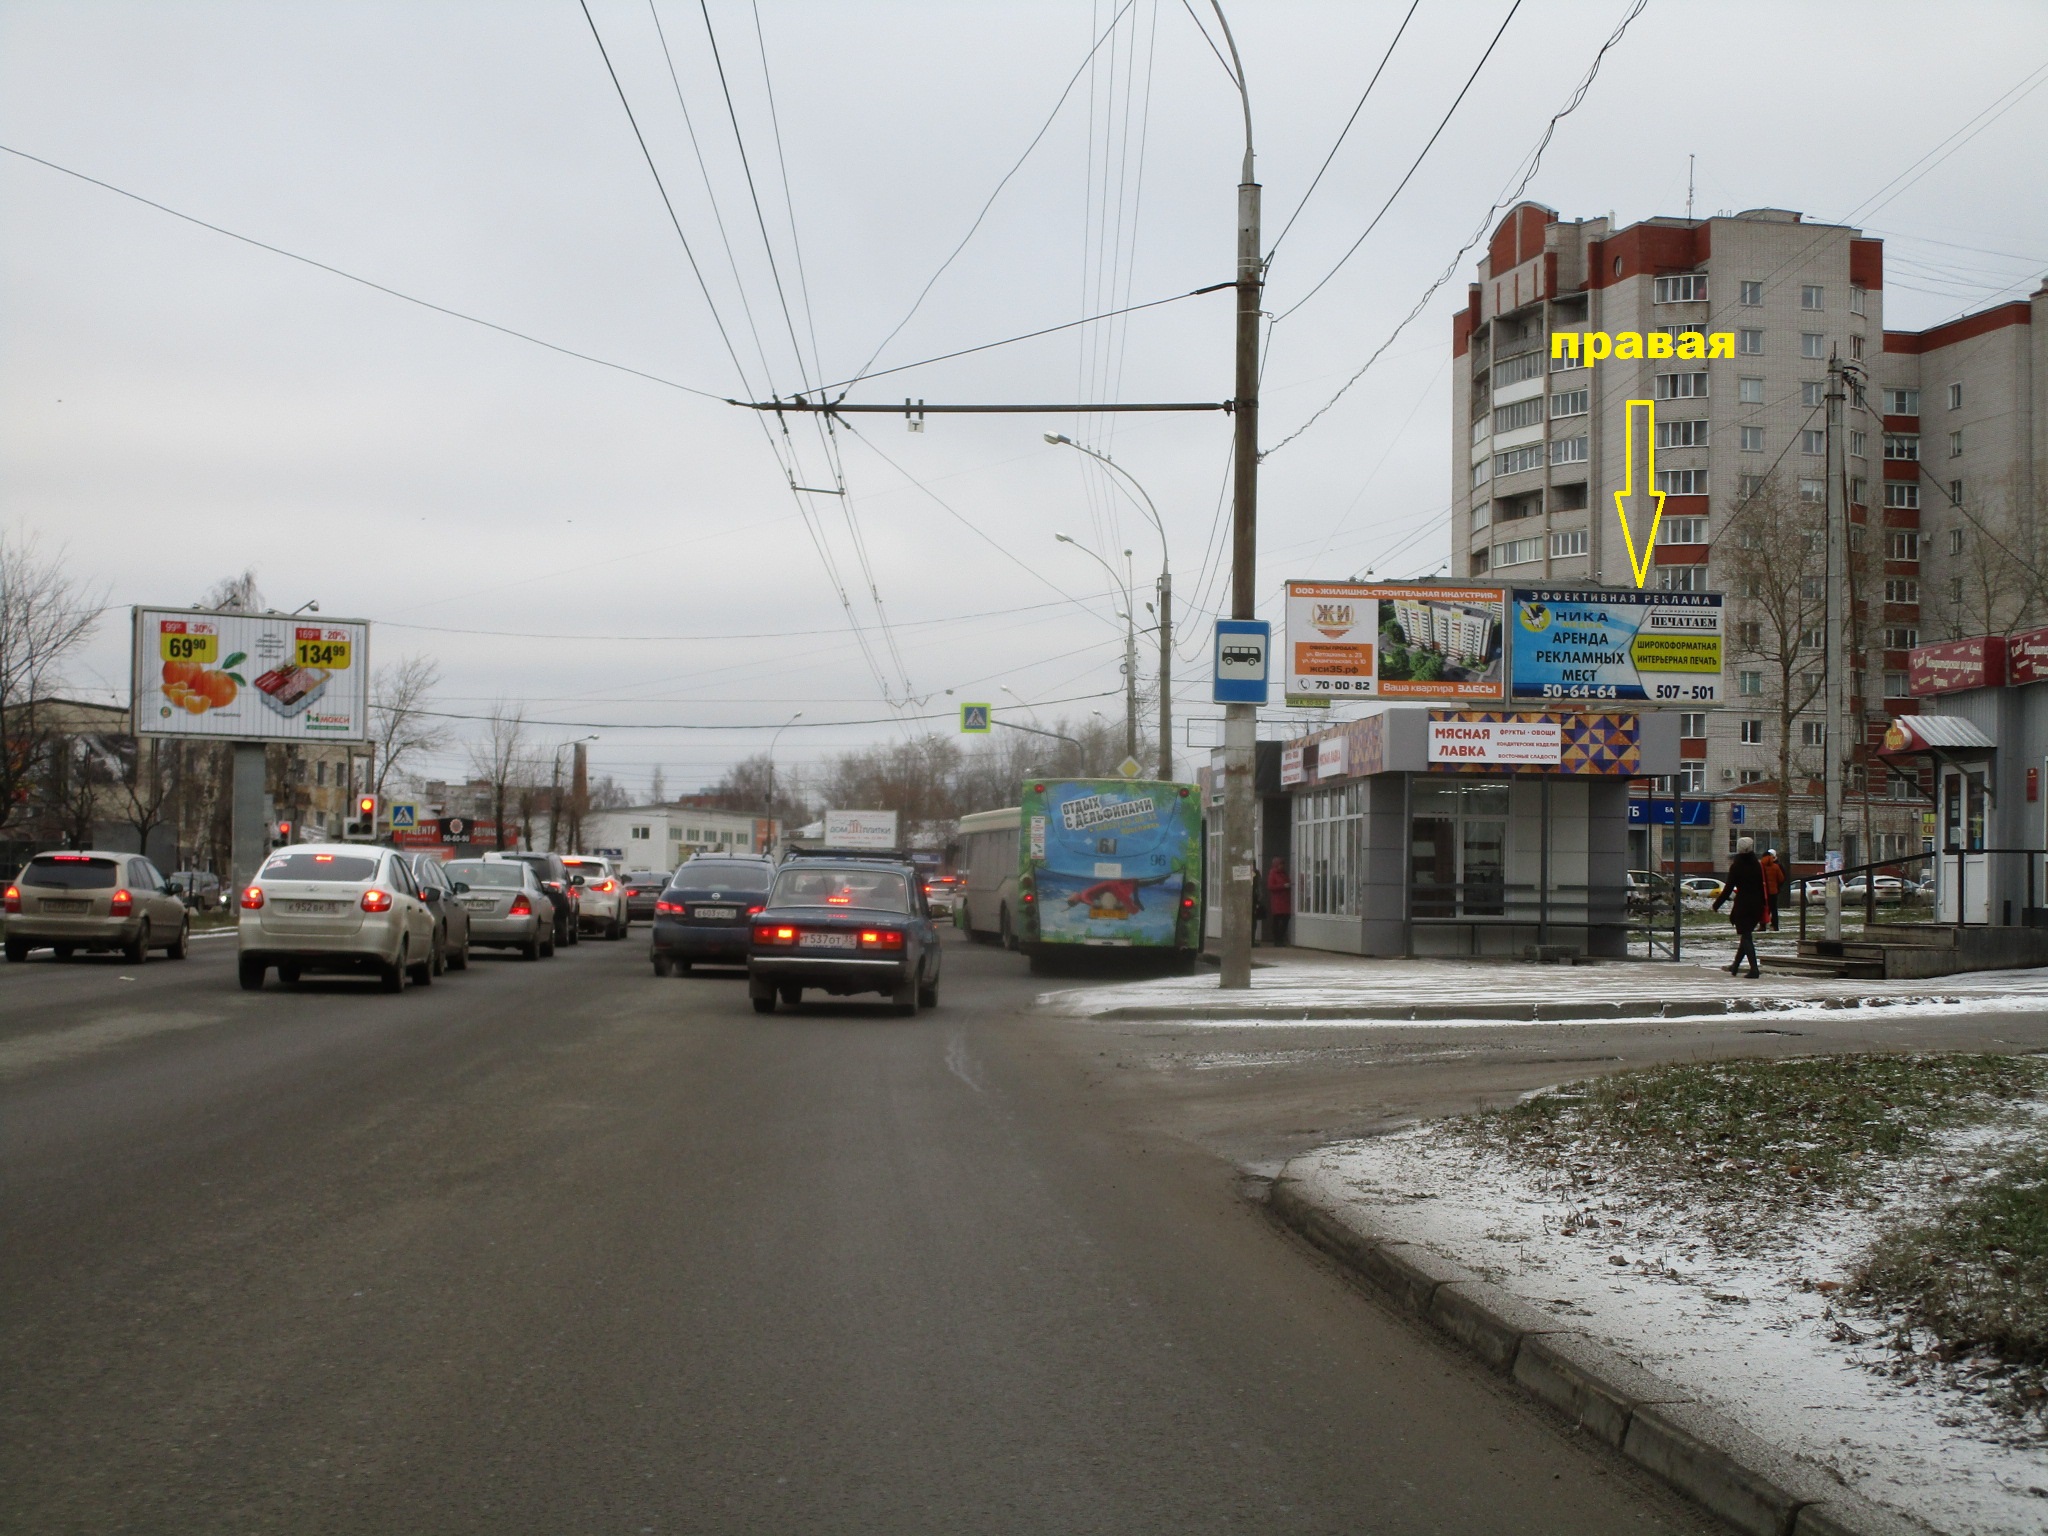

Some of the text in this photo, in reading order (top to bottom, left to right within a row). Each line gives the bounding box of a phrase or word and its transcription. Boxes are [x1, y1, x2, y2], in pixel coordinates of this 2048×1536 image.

[1532, 591, 1711, 605] ЭФФЕКТИВНАЯ РЕКЛАМА
[1555, 612, 1609, 622] НИКА
[1651, 616, 1717, 627] ПЕЧАТАЕМ
[1552, 632, 1609, 645] АРЕНДА
[1637, 640, 1716, 650] ШИРОКОФОРМАТНАЯ
[1537, 651, 1625, 664] РЕКЛАМНЫХ
[1637, 655, 1716, 665] ИНТЕРЬЕРНАЯ ПЕЧАТЬ
[1562, 670, 1597, 681] МЕСТ
[1384, 683, 1496, 694] Ваша квартира ЗДЕСЬ!
[1543, 684, 1617, 698] 50-64-64
[1435, 728, 1490, 740] МЯСНАЯ
[1439, 746, 1486, 757] ЛАВКА
[1062, 797, 1100, 815] ОТДЫХ
[1066, 816, 1073, 828] С
[1075, 799, 1152, 828] ДЕЛЬФИНАМИ
